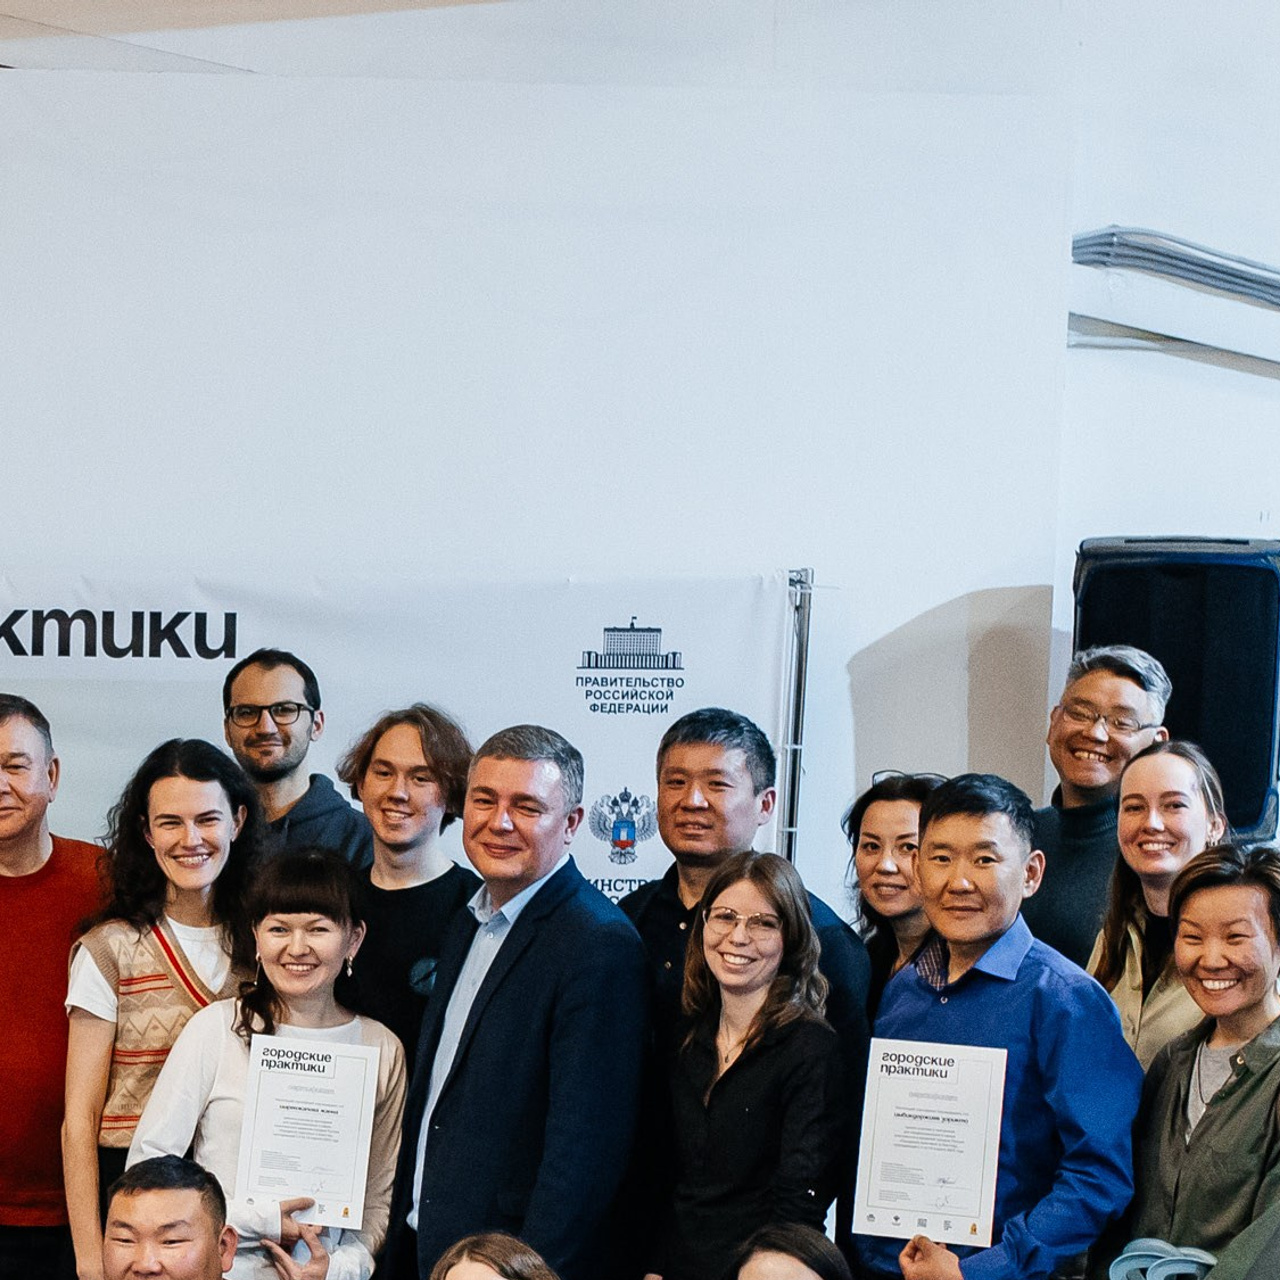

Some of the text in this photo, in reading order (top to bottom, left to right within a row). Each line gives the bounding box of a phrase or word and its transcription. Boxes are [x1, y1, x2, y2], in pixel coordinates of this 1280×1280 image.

[575, 676, 685, 688] ПРАВИТЕЛЬСТВО
[584, 688, 674, 701] РОССИЙСКОЙ
[589, 702, 669, 714] ФЕДЕРАЦИИ
[262, 1047, 332, 1063] городские
[881, 1052, 955, 1067] городские
[261, 1058, 326, 1073] практики
[880, 1063, 948, 1078] практики
